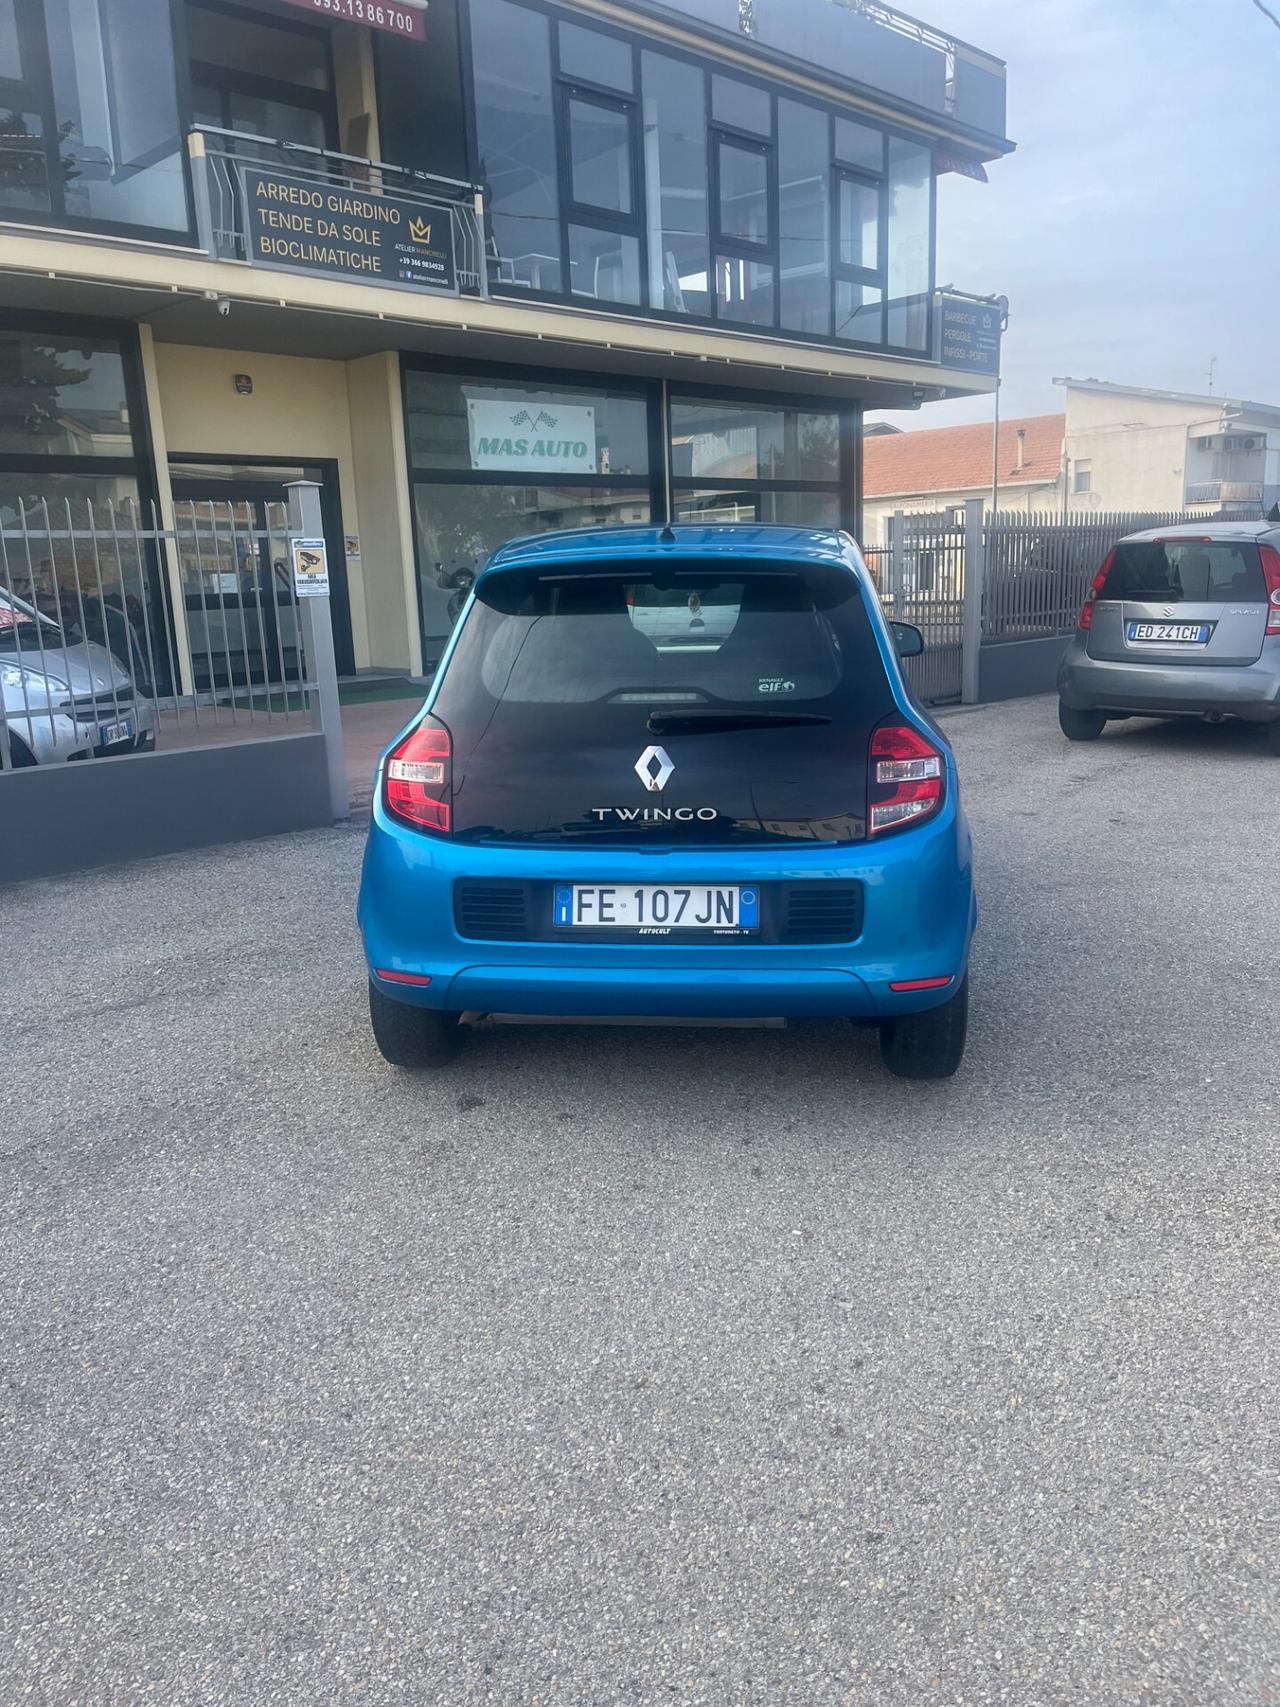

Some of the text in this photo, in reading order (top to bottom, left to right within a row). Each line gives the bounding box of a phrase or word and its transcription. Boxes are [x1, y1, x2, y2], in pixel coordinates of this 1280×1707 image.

[256, 181, 401, 225] ARREDO GIARDINO
[258, 208, 381, 247] TENDE DA SOLE
[260, 236, 382, 272] BIOCLIMATICHE
[395, 243, 416, 253] ATELIER
[478, 437, 588, 458] MAS AUTO
[1137, 625, 1153, 638] ED
[1157, 626, 1199, 640] 241CH
[758, 682, 782, 692] elf
[591, 807, 718, 821] TWINGO
[577, 889, 616, 922] FE
[634, 889, 734, 924] 107JN
